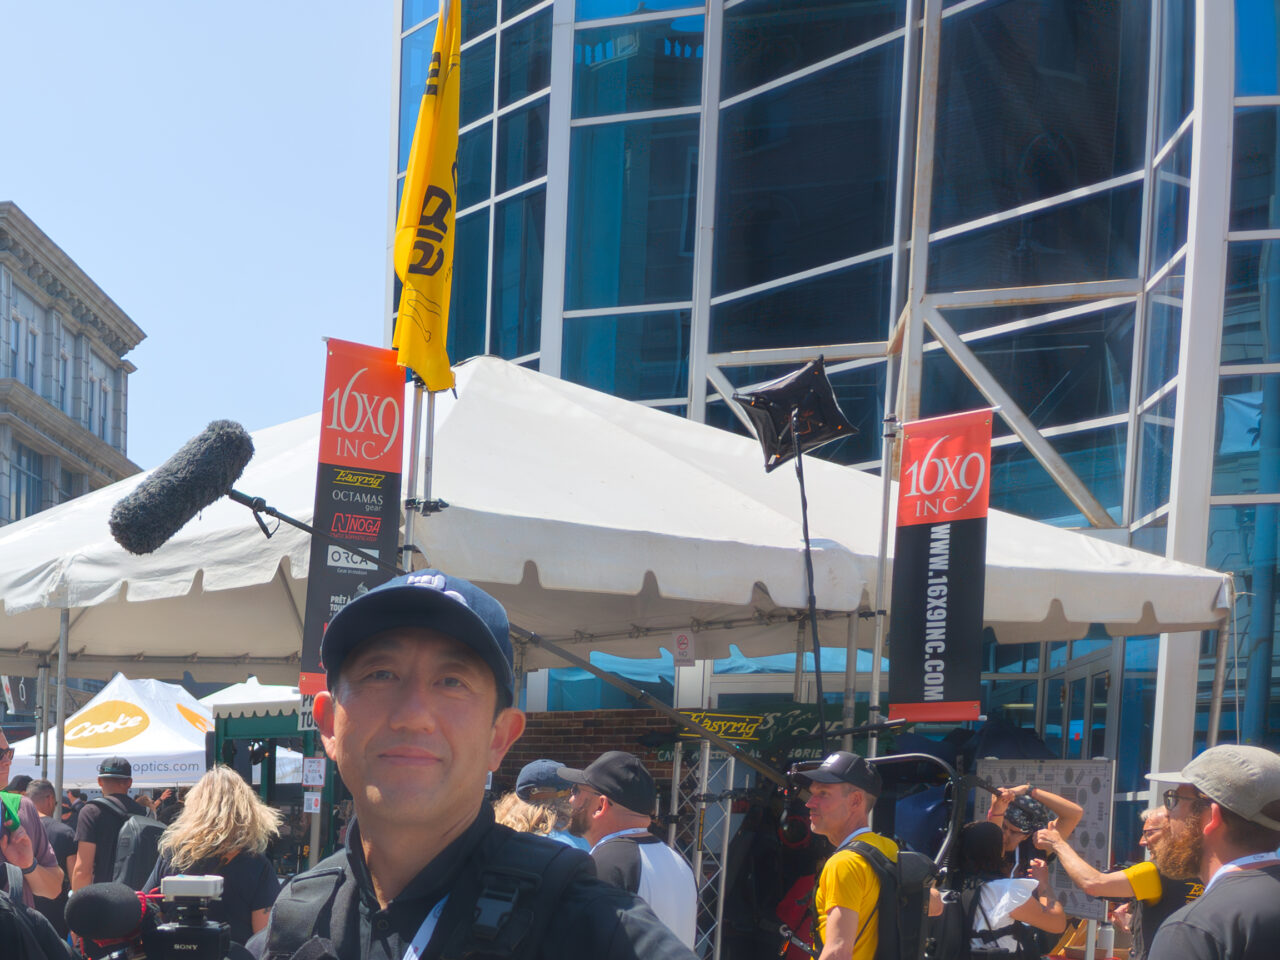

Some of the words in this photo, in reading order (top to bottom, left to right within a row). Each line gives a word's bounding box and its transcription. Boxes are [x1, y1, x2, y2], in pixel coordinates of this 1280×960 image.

[336, 437, 384, 461] INC.
[335, 470, 385, 487] Easyrig
[332, 489, 383, 506] OCTAMAS
[915, 496, 968, 517] INC.
[365, 504, 382, 512] gear
[349, 518, 381, 534] NOGA
[331, 551, 368, 566] ORCA
[924, 523, 951, 701] WWW.16X9INC.COM
[65, 713, 144, 741] Cooke
[684, 711, 763, 738] Easyrig
